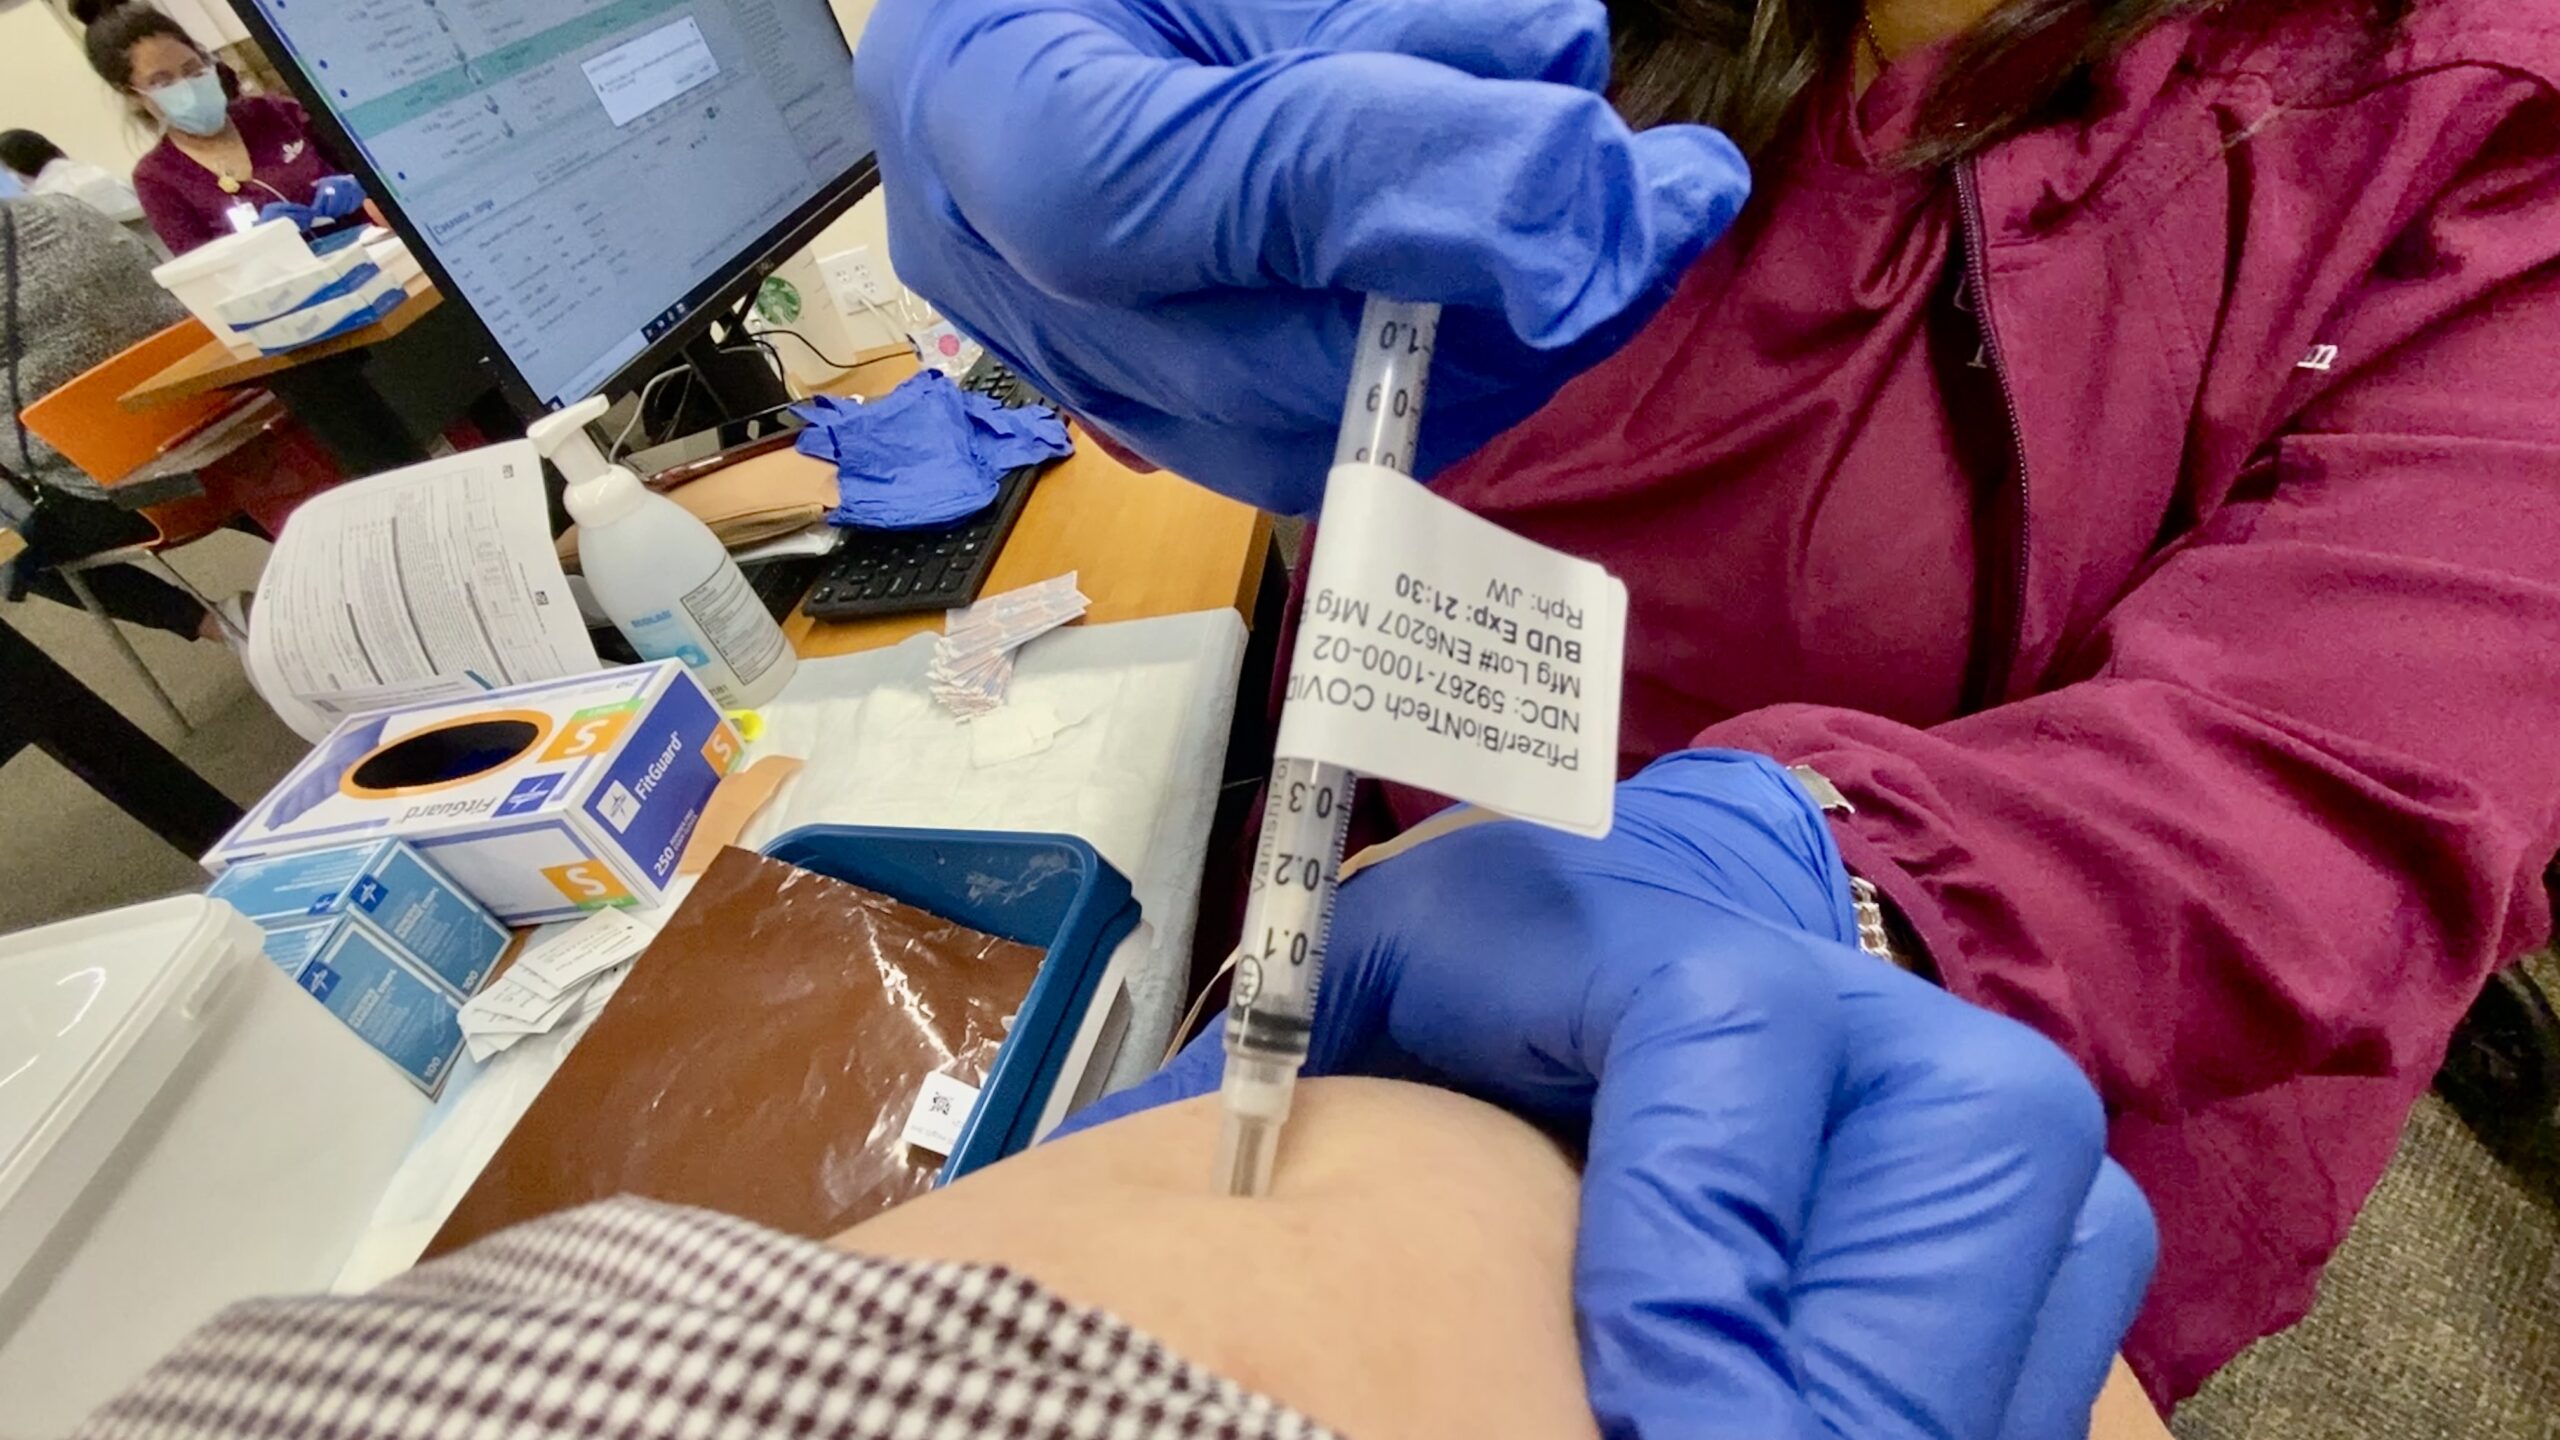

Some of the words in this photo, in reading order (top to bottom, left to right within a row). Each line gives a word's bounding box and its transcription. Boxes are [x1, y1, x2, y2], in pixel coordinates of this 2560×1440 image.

[1379, 320, 1420, 355] 1.0
[1365, 384, 1409, 418] 09
[1315, 588, 1370, 628] Mfg
[1394, 572, 1459, 621] 21:30
[1485, 578, 1524, 608] JW
[1466, 604, 1519, 645] Exp:
[1530, 594, 1584, 630] Rph:
[1377, 610, 1472, 666] EN6207
[1525, 629, 1582, 664] BUD
[1312, 634, 1506, 715] 59267-1000-02
[1478, 648, 1529, 685] Lot#
[1536, 663, 1581, 699] Mfg
[1385, 692, 1579, 771] Pfizer/BioNTech
[1513, 698, 1581, 734] NDC:
[563, 719, 609, 756] S
[712, 733, 733, 763] S
[633, 732, 682, 800] FitGuard
[402, 797, 497, 823] FitGuard
[1288, 781, 1333, 819] 0.3
[653, 847, 675, 877] 250
[1274, 853, 1320, 891] 0.2
[564, 866, 607, 896] S
[1263, 926, 1309, 966] 0.1
